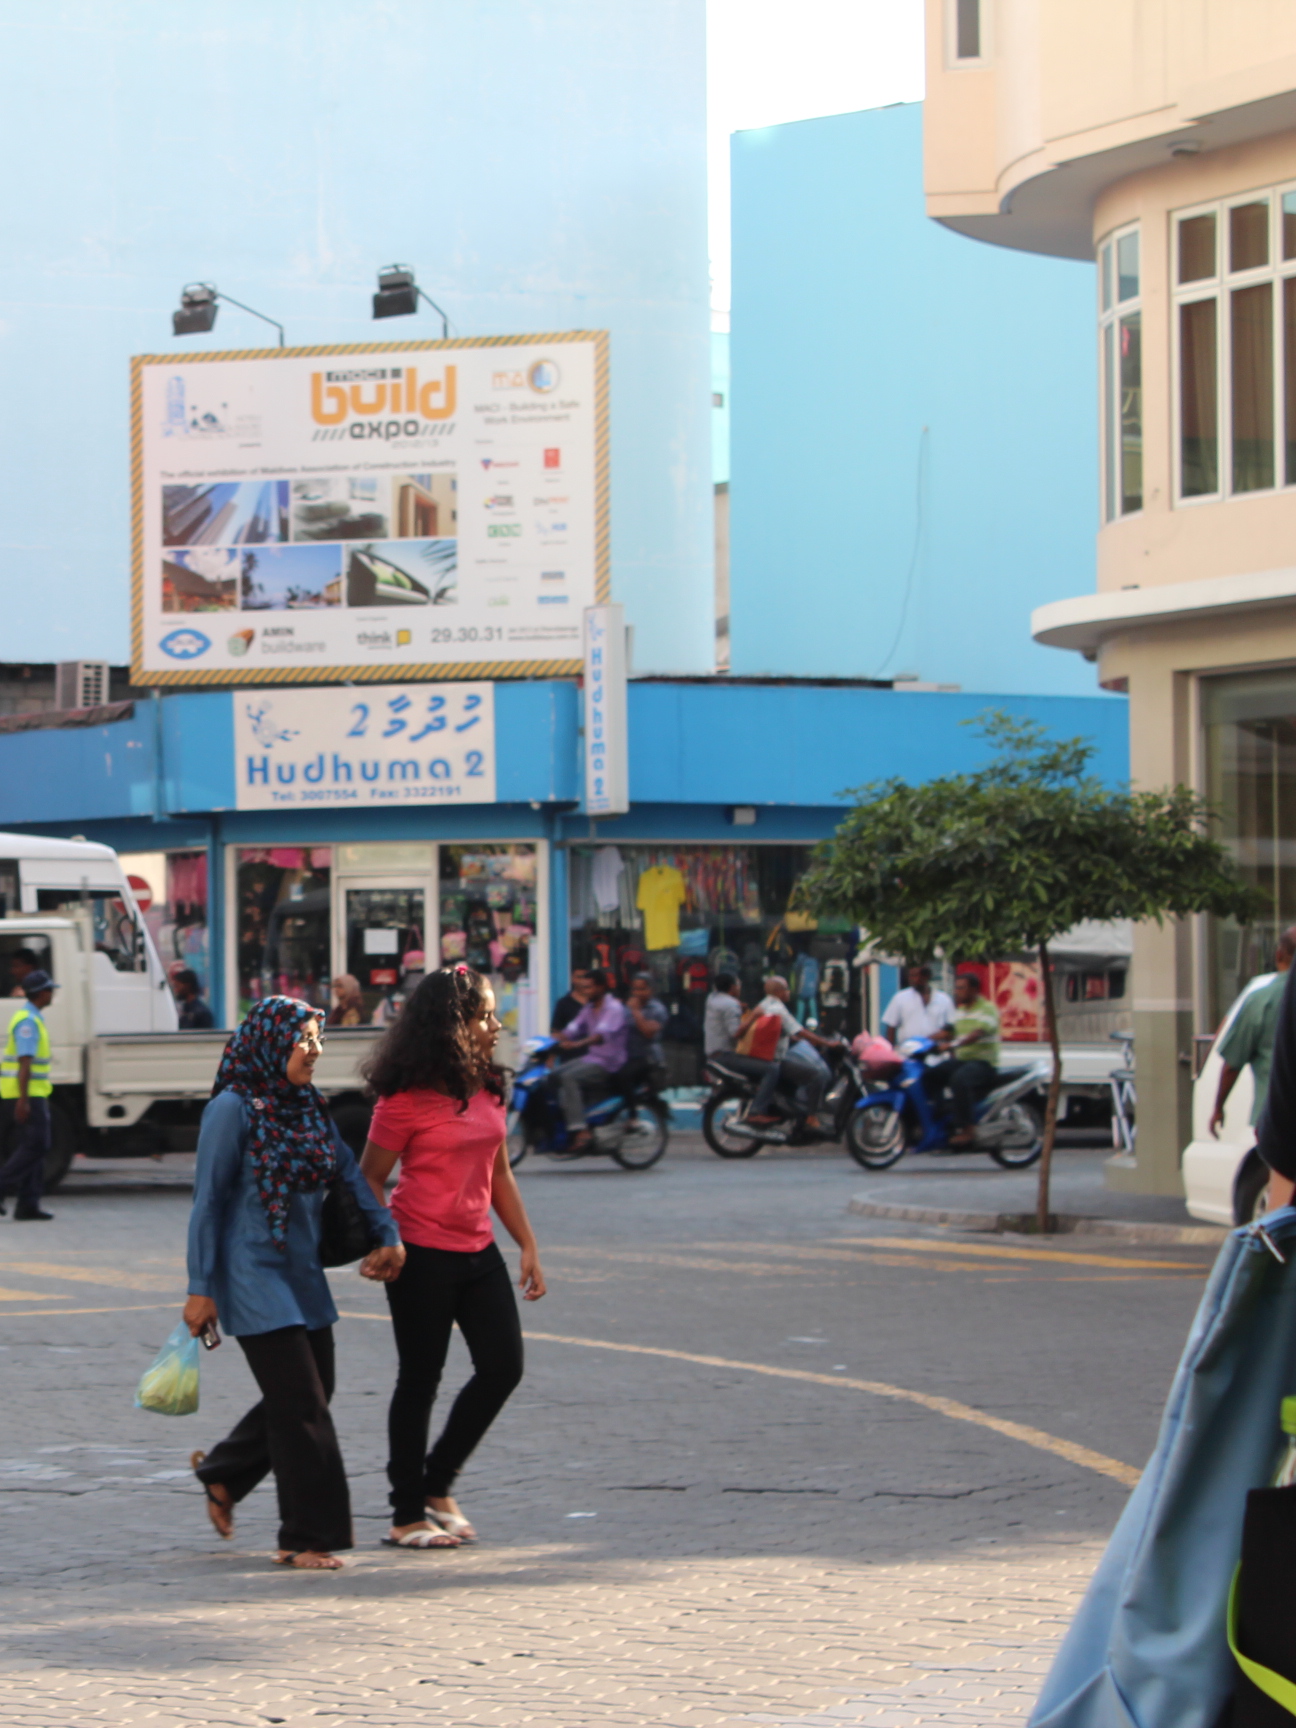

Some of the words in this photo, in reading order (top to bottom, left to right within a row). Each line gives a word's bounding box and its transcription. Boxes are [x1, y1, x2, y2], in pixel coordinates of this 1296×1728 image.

[311, 365, 457, 426] build
[349, 420, 420, 441] expo
[357, 630, 392, 645] think
[431, 626, 503, 643] 29.30.31
[261, 639, 327, 654] buildware
[247, 754, 451, 785] Hudhuma
[465, 751, 485, 777] 2
[271, 791, 296, 801] Tel:
[370, 788, 399, 799] Fax:
[404, 786, 462, 799] 3322191
